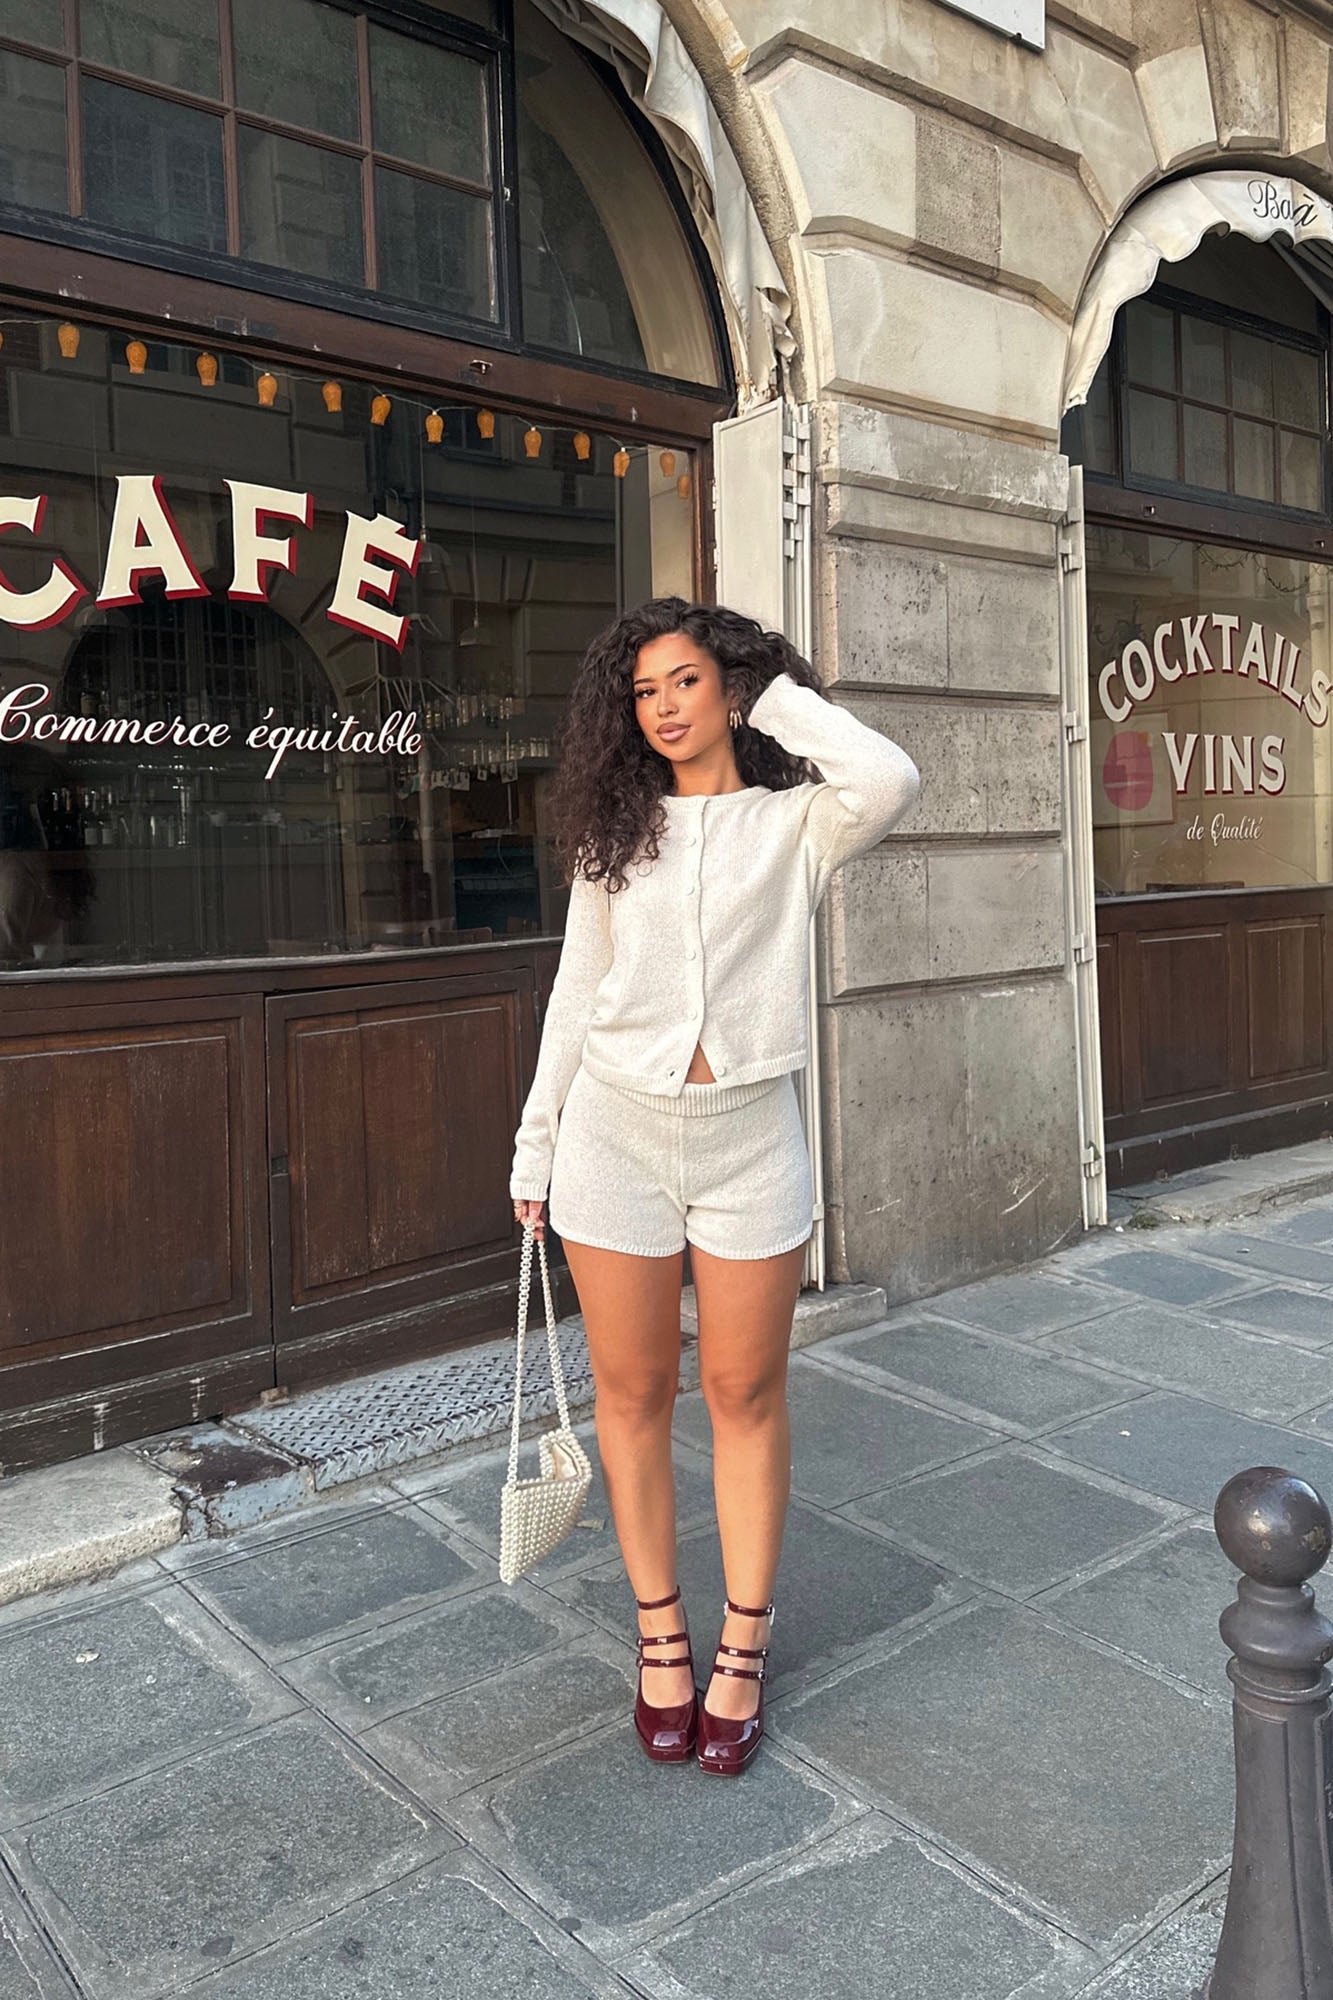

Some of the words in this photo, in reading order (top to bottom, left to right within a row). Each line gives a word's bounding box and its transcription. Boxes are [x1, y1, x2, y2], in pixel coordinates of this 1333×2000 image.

[1098, 612, 1333, 728] COCKTAILS
[0, 683, 231, 748] Commerce
[246, 707, 422, 781] équitable
[1161, 732, 1287, 796] VINS
[1186, 815, 1204, 840] de
[1210, 813, 1263, 846] Qualité
